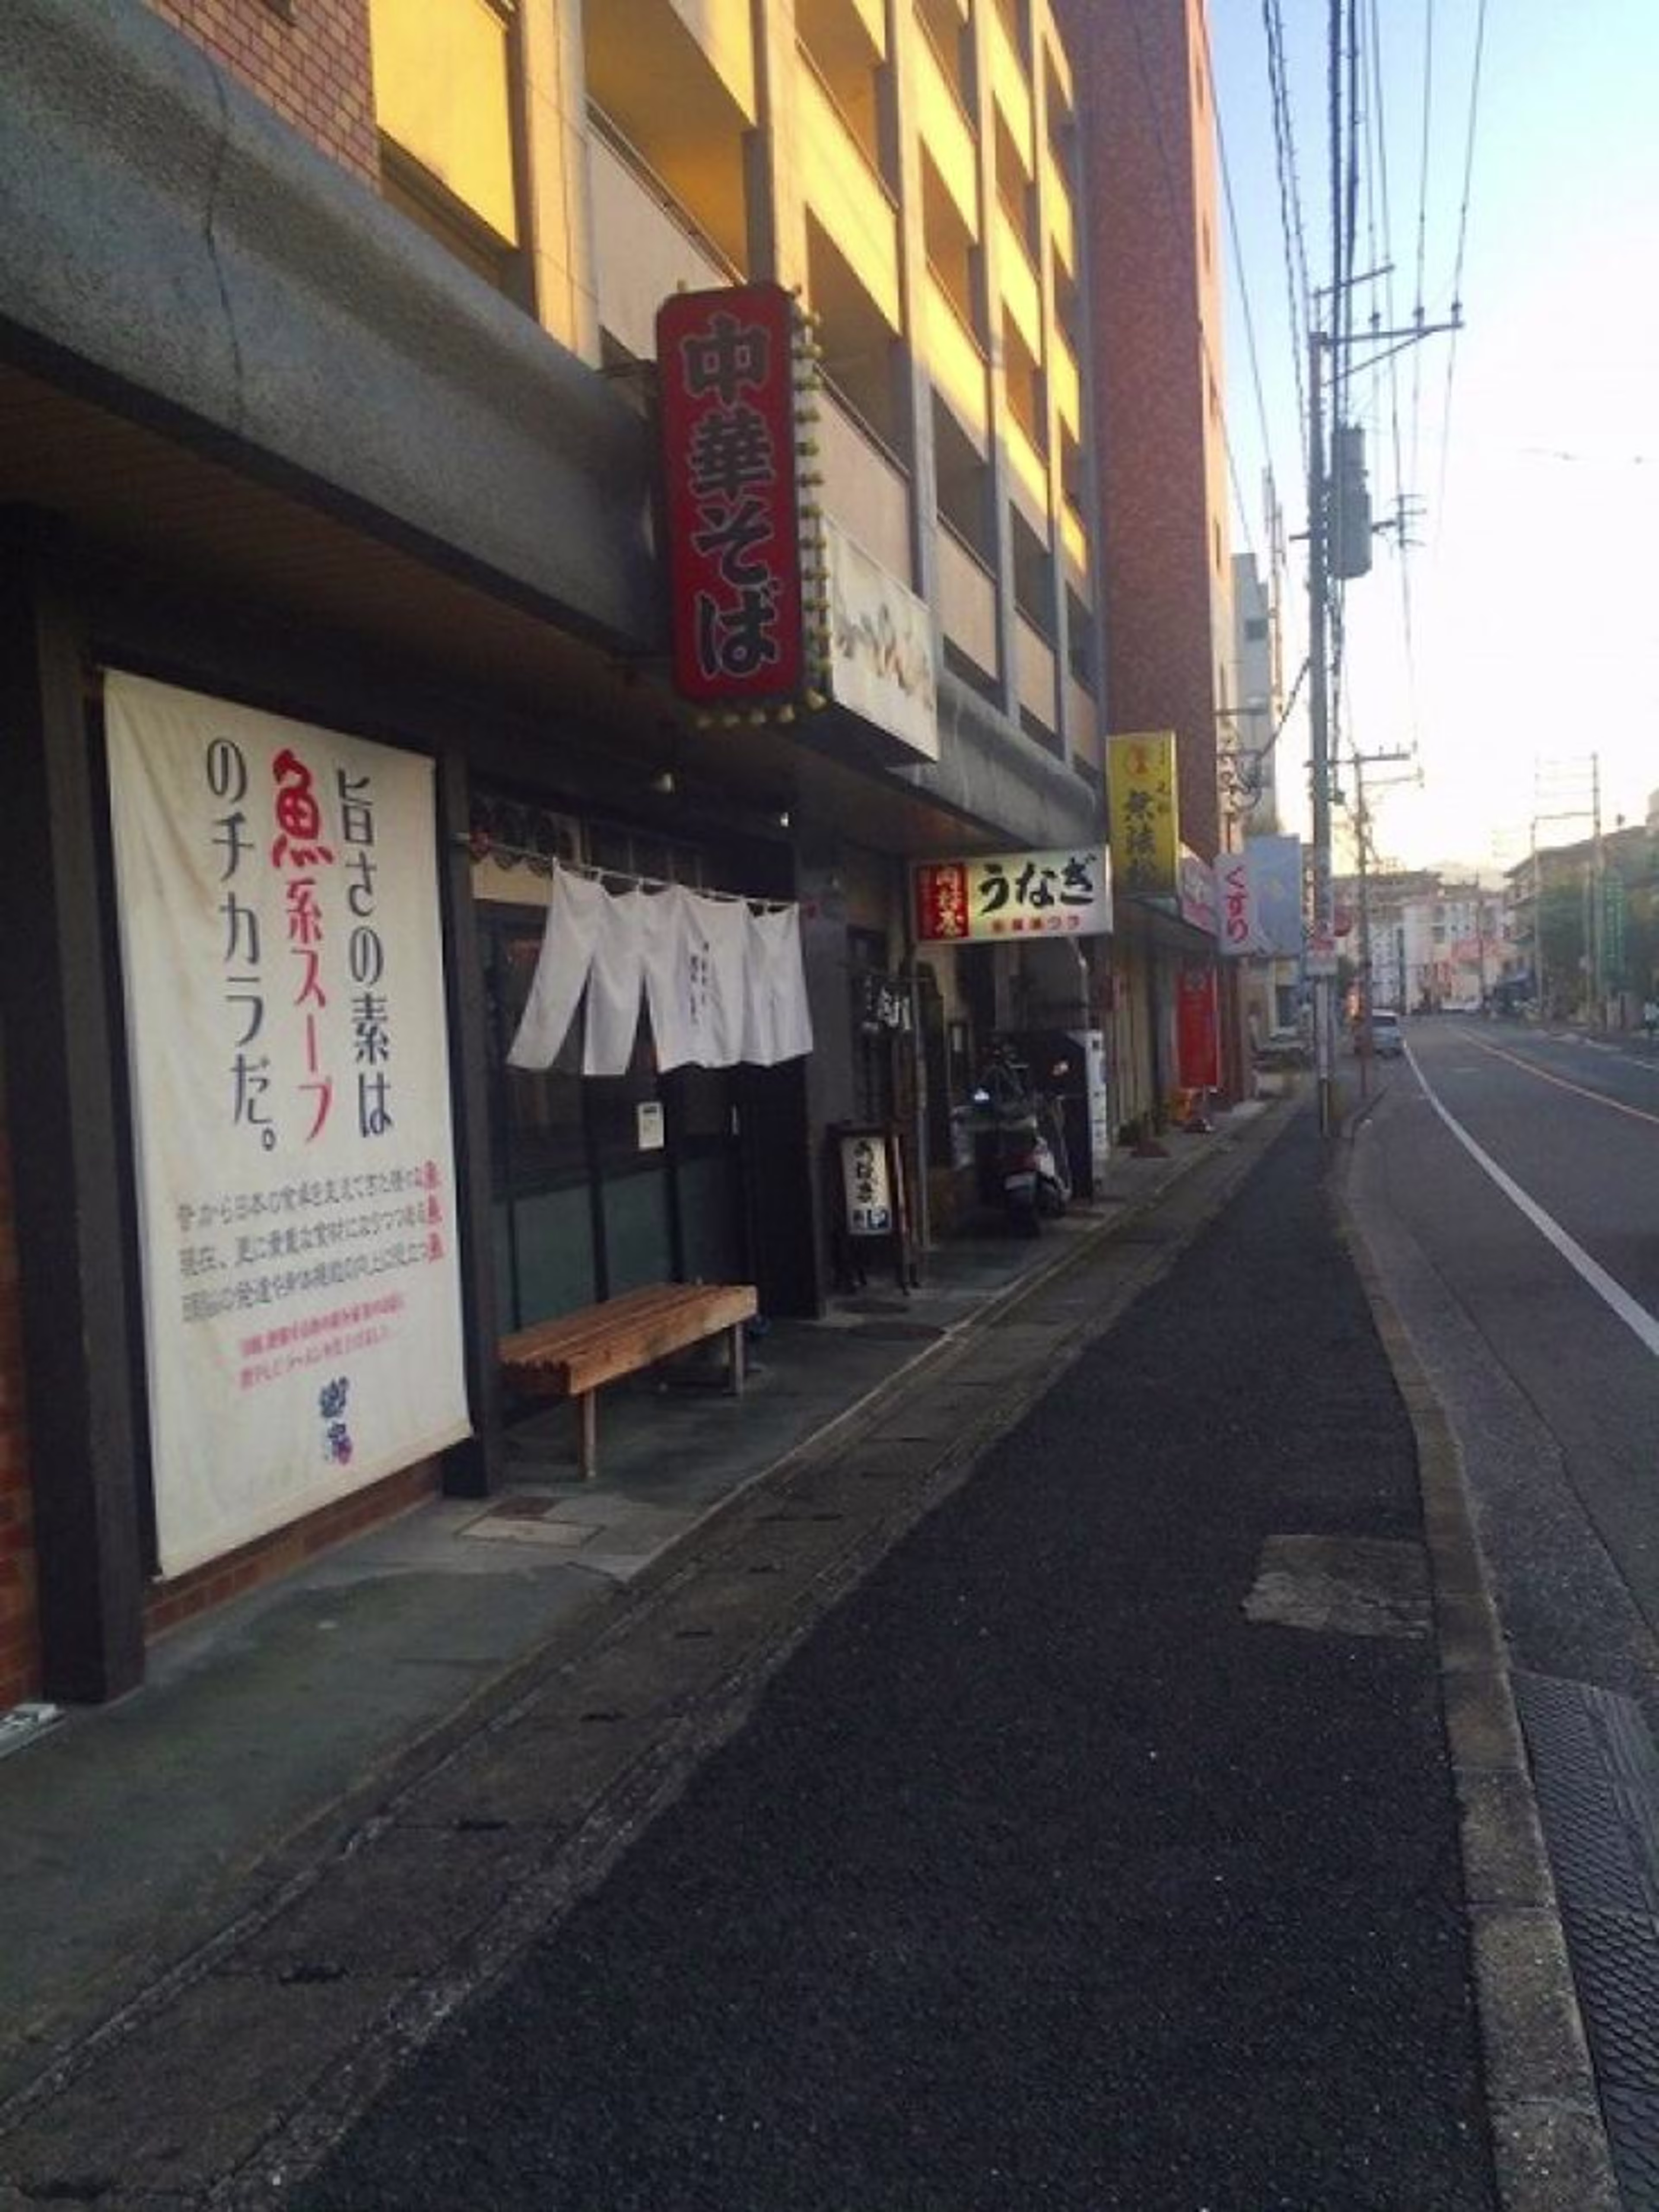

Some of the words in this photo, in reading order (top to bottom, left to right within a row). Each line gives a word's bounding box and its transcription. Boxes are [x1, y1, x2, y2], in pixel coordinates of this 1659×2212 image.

[682, 309, 780, 678] 中華そば
[207, 737, 276, 1152] のチカラだ。
[271, 748, 334, 1144] 魚系スープ
[337, 767, 391, 1139] 旨さの素は
[978, 853, 1097, 916] うなぎ
[1226, 864, 1249, 944] くすり
